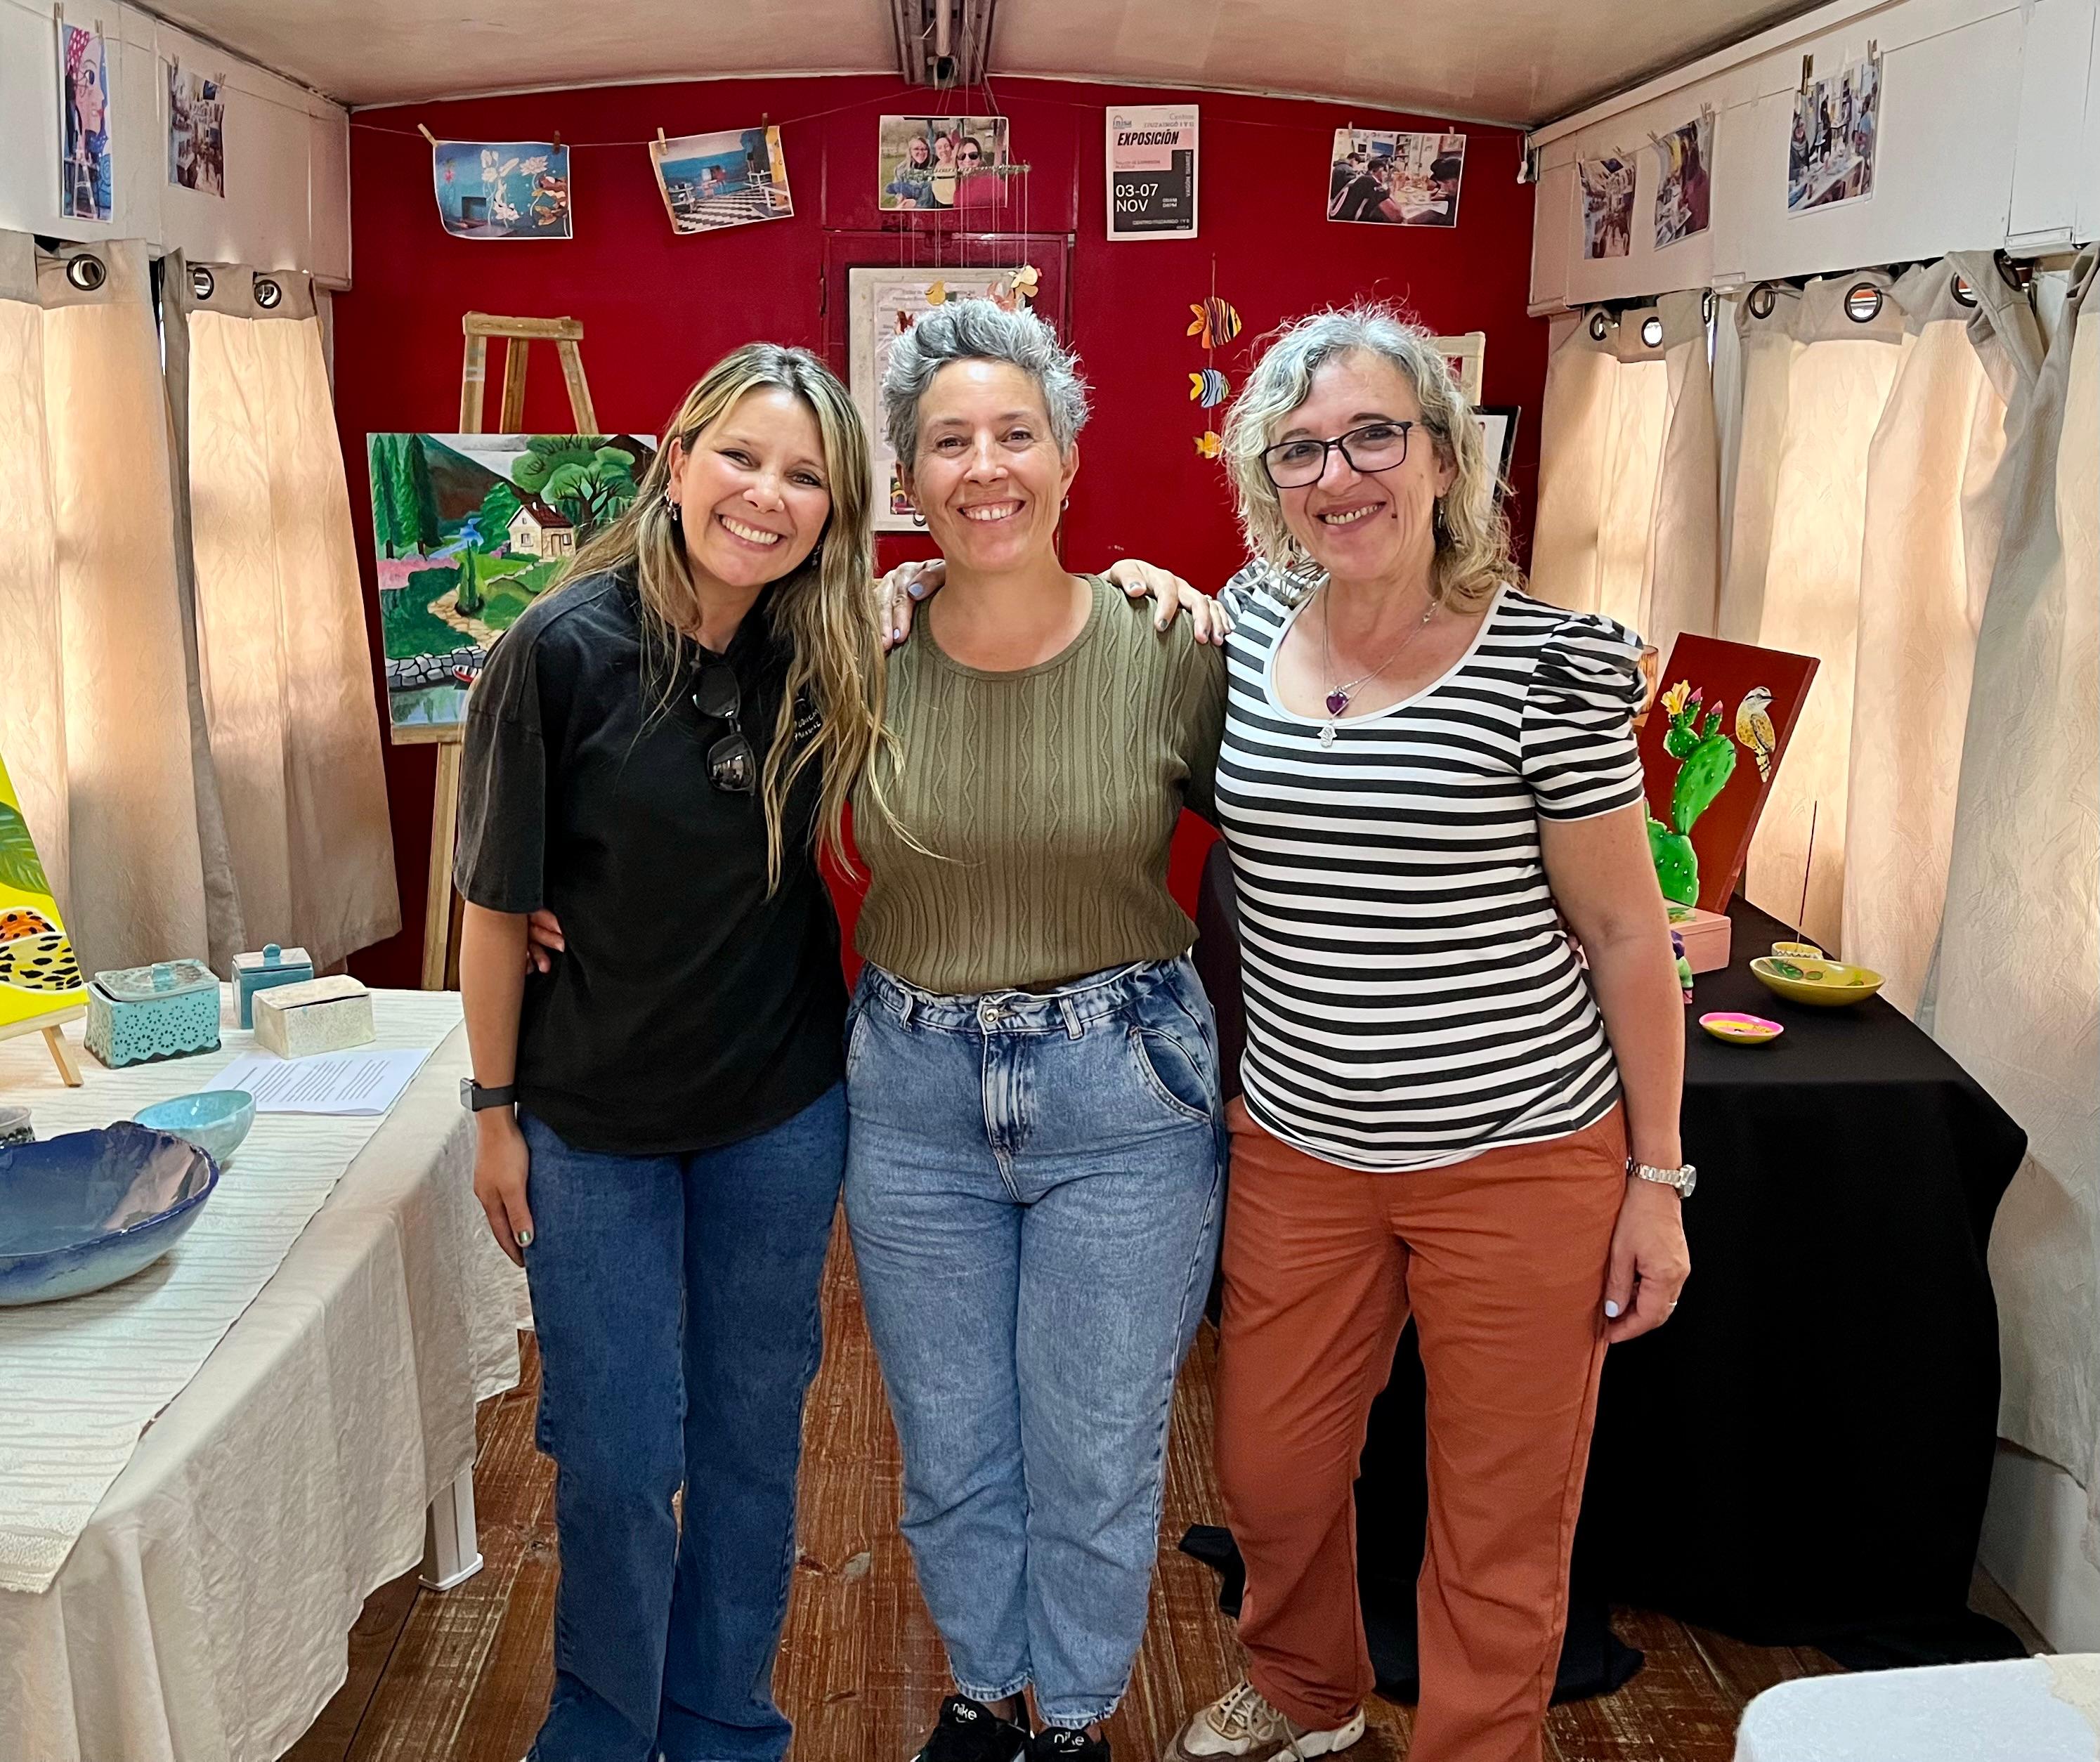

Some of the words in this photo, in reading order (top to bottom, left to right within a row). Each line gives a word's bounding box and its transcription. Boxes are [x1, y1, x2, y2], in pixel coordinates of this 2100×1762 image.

[1117, 129, 1180, 146] EXPOSICIÓN
[1115, 183, 1159, 197] 03-07
[1116, 199, 1149, 212] NOV
[952, 1703, 977, 1721] nike
